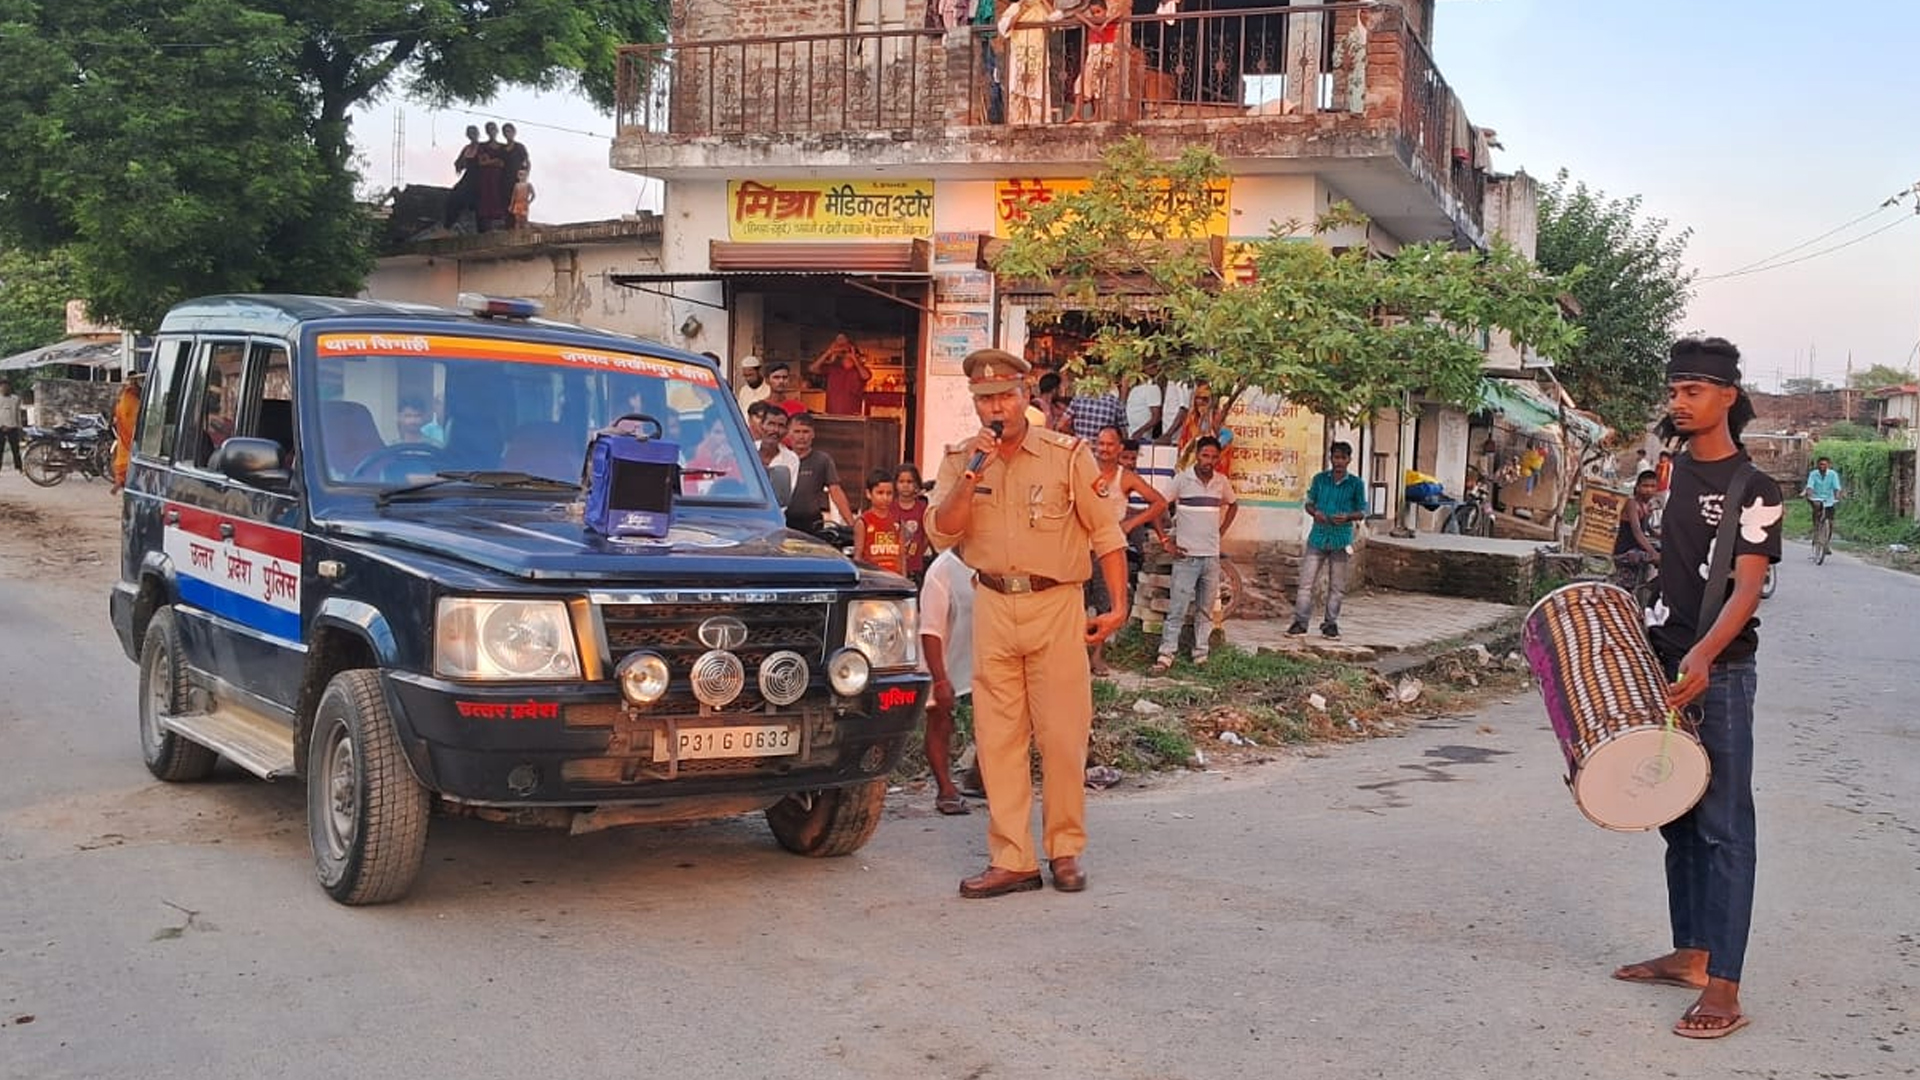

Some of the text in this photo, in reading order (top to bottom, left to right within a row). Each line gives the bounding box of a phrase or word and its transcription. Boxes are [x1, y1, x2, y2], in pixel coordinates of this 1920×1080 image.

[825, 184, 893, 217] मेडिकल
[325, 339, 367, 352] थाना
[190, 543, 298, 602] उत्तर प्रदेश पुलिस
[456, 698, 558, 719] उत्तर प्रदेश
[878, 687, 917, 710] पुलिस
[679, 734, 714, 752] P31
[743, 730, 789, 749] 0633
